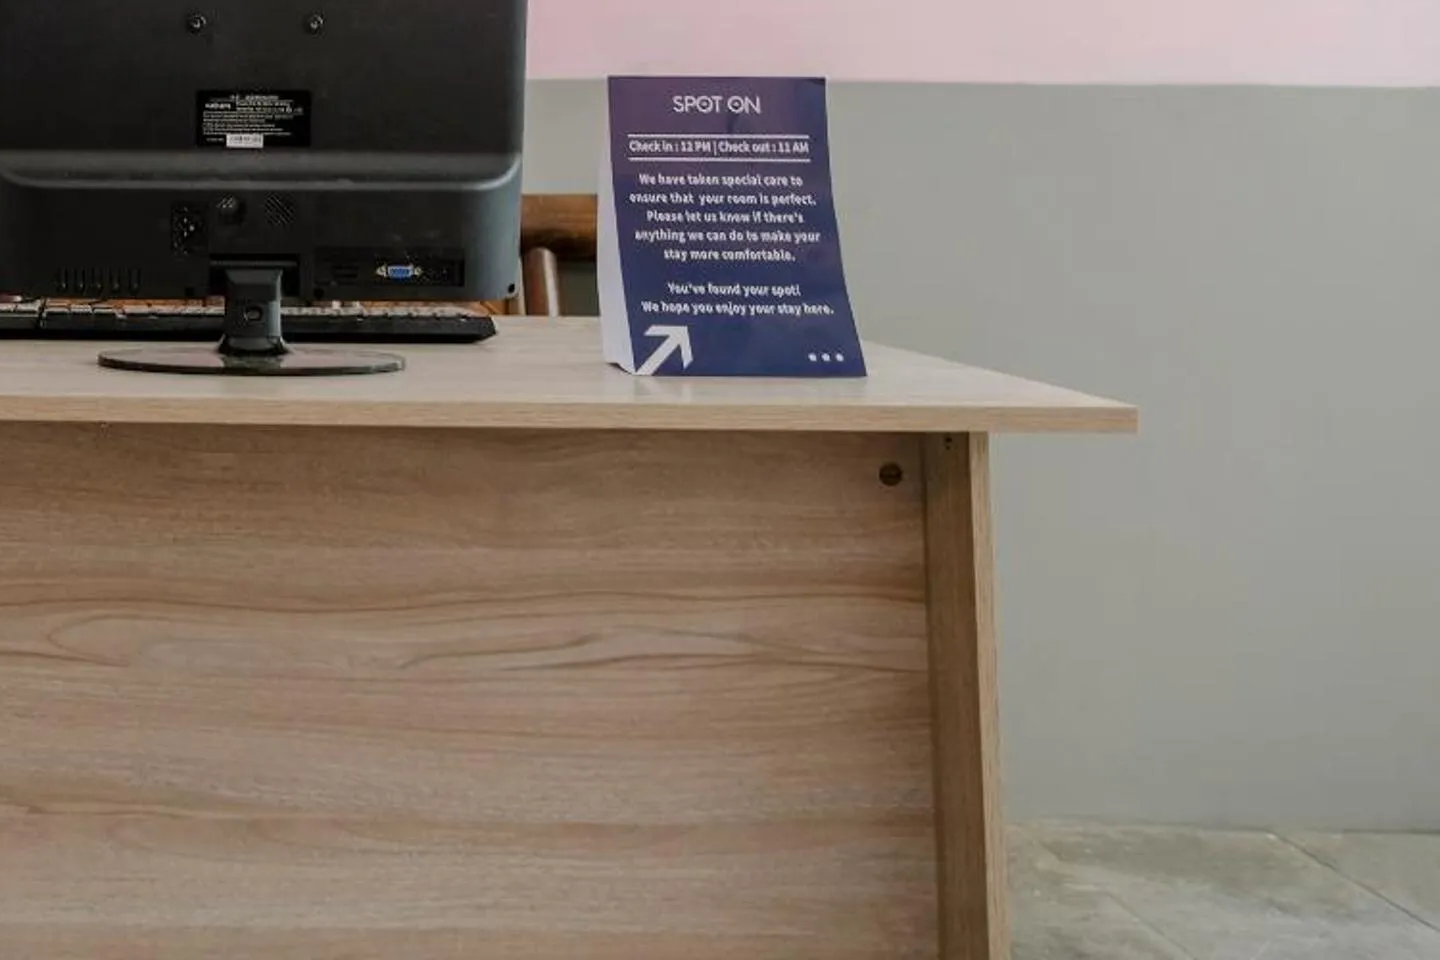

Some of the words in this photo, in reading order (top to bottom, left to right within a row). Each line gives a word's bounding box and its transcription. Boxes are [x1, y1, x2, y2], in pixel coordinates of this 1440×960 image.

[672, 95, 723, 114] SPOT
[727, 95, 761, 114] ON
[629, 140, 661, 153] Check
[662, 140, 674, 153] in
[681, 141, 694, 152] 12
[694, 141, 712, 152] PM
[718, 140, 751, 153] Check
[752, 142, 770, 153] out
[778, 142, 791, 153] 11
[792, 141, 809, 153] AM
[639, 173, 656, 185] We
[658, 172, 686, 186] have
[687, 172, 719, 186] taken
[721, 172, 762, 188] special
[763, 175, 789, 187] care
[790, 175, 803, 187] to
[629, 193, 668, 204] ensure
[670, 192, 695, 204] that
[699, 194, 725, 206] your
[727, 194, 758, 205] room
[758, 192, 770, 205] is
[771, 193, 817, 207] perfect.
[646, 209, 683, 222] Please
[684, 210, 702, 222] let
[703, 211, 717, 222] us
[719, 211, 750, 223] know
[752, 210, 762, 223] if
[763, 211, 804, 224] there's
[635, 228, 686, 244] anything
[687, 232, 704, 241] we
[706, 231, 727, 242] can
[729, 229, 744, 242] do
[746, 230, 759, 242] to
[761, 230, 792, 242] make
[793, 231, 821, 245] your
[663, 249, 688, 262] stay
[689, 250, 720, 261] more
[721, 248, 796, 262] comfortable.
[667, 282, 706, 295] You've
[708, 281, 740, 296] found
[742, 285, 769, 298] your
[641, 300, 659, 312] We
[660, 300, 690, 316] hope
[691, 303, 714, 316] you
[715, 301, 746, 316] enjoy
[748, 304, 775, 316] your
[777, 302, 802, 317] stay
[802, 302, 835, 315] here.
